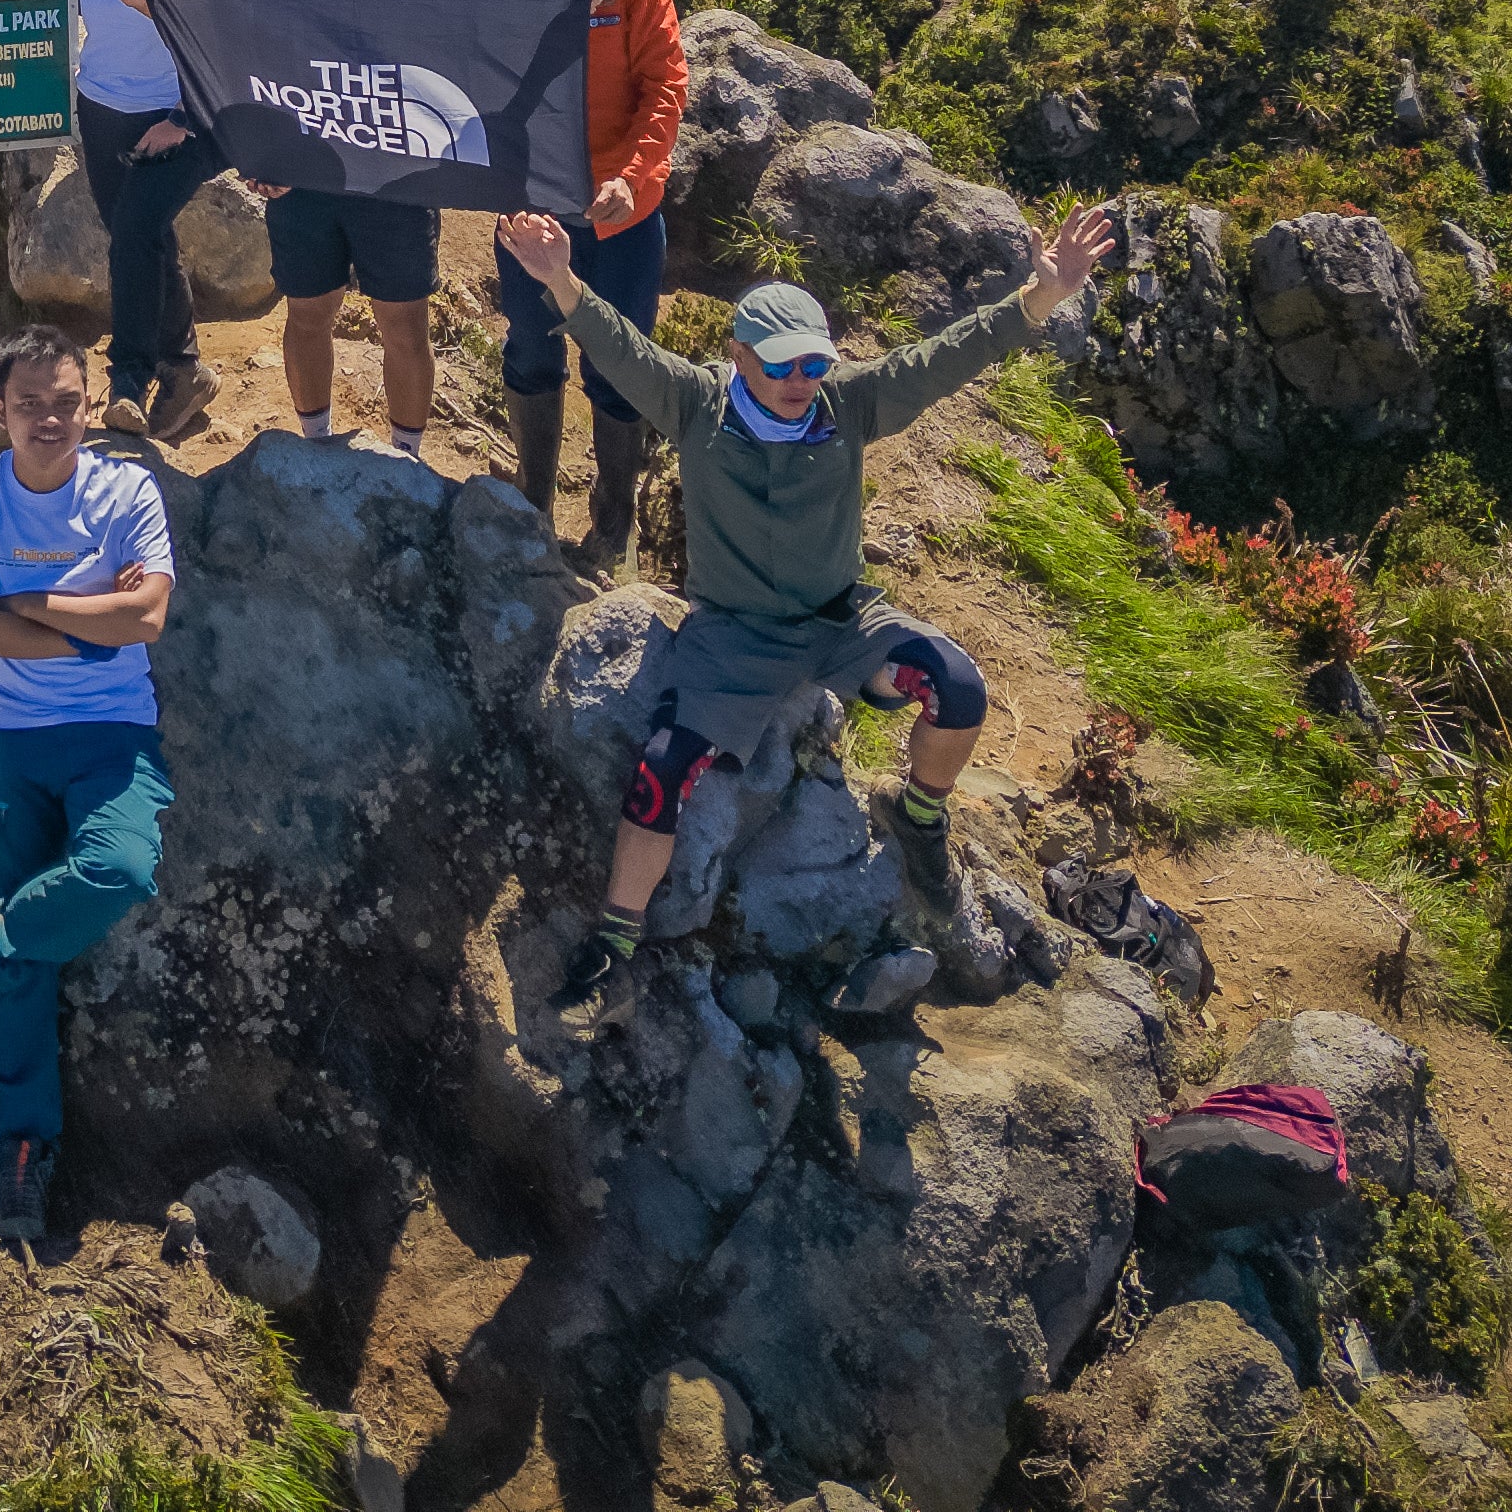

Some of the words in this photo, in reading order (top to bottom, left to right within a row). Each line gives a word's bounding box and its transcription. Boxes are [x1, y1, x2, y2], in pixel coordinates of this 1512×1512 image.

[11, 8, 61, 31] PARK
[309, 60, 399, 99] THE
[249, 75, 403, 128] NORTH
[297, 111, 407, 155] FACE
